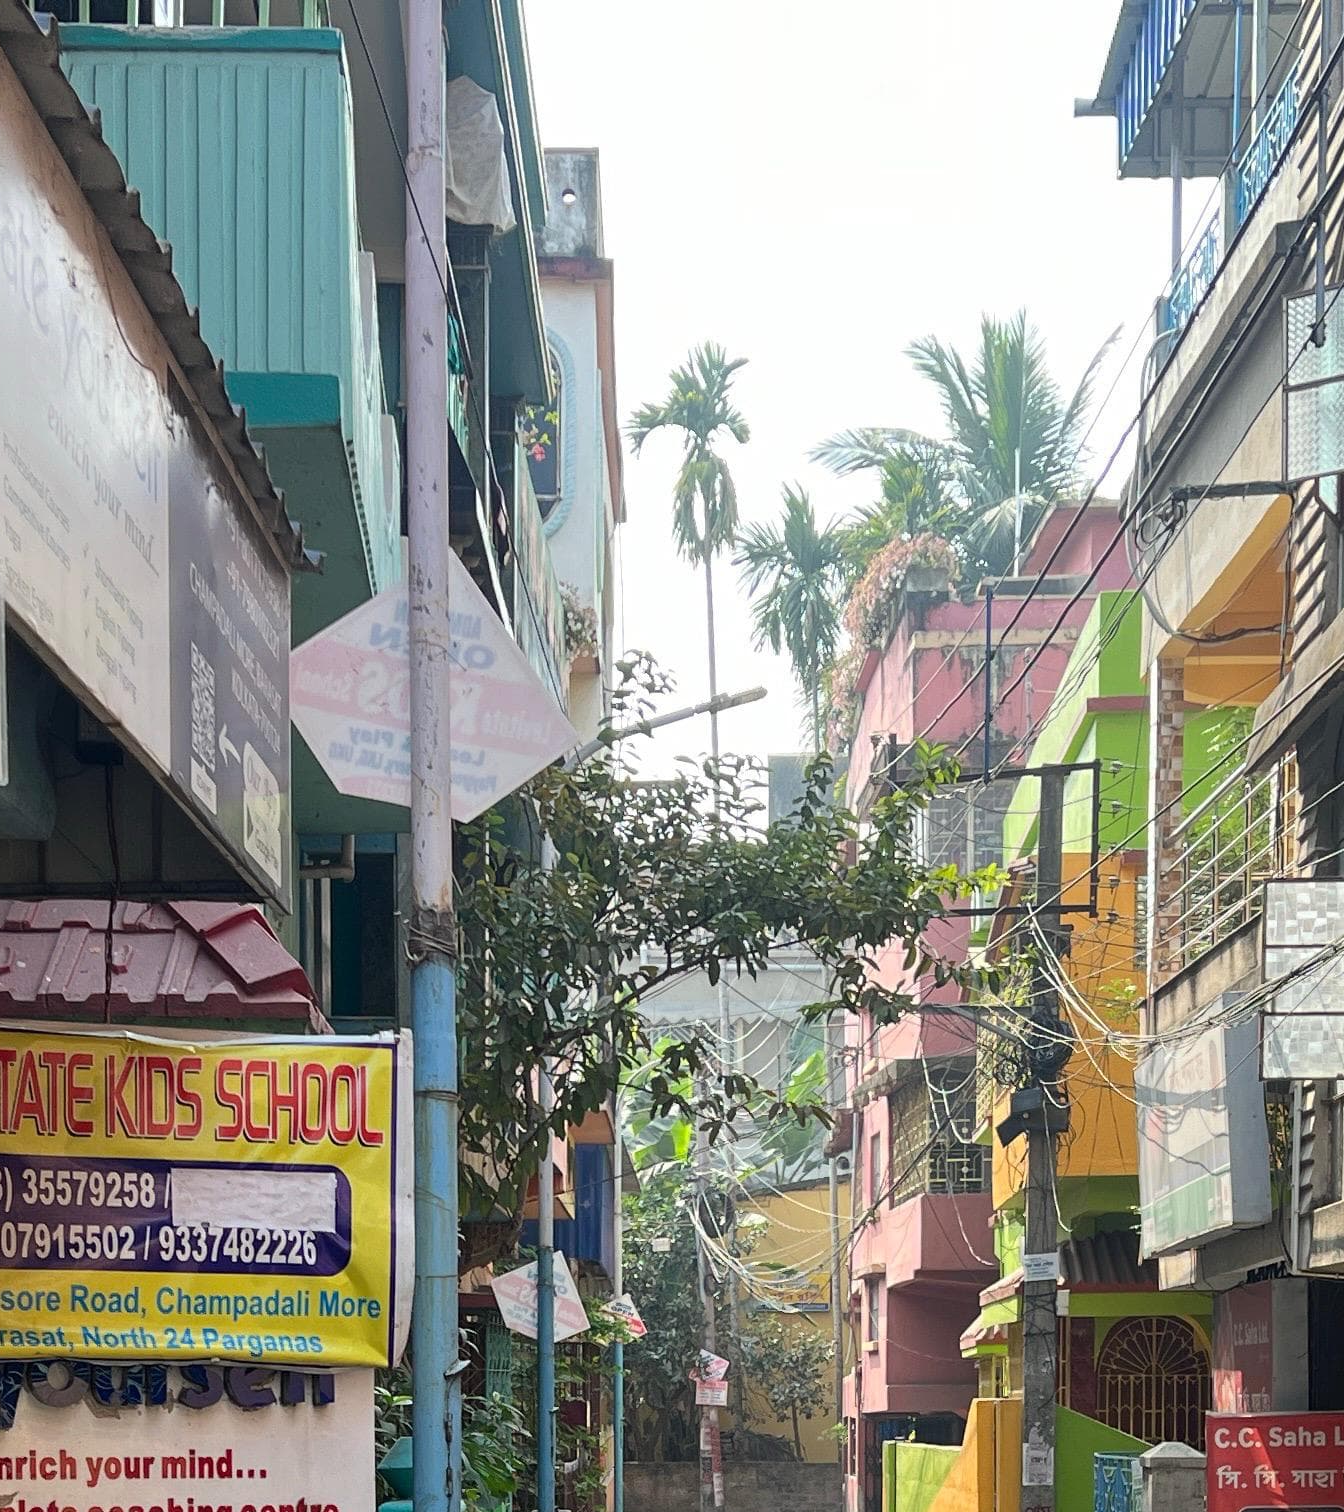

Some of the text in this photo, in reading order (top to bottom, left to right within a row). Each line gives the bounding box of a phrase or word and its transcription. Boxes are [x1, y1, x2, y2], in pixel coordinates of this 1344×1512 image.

[93, 465, 122, 520] your
[107, 1052, 204, 1141] KIDS
[216, 1059, 385, 1147] SCHOOL
[21, 1166, 155, 1210] 35579258
[158, 1226, 318, 1267] 9337482226
[69, 1284, 147, 1318] Road,
[155, 1286, 311, 1326] Champadali
[318, 1289, 382, 1320] More
[81, 1325, 156, 1350] North
[163, 1328, 195, 1352] 24
[201, 1329, 324, 1357] Parganas
[1213, 1426, 1263, 1449] C.C.
[1268, 1426, 1326, 1447] Saha
[86, 1454, 155, 1488] your
[160, 1448, 268, 1480] mind...
[1291, 1468, 1338, 1490] সাহা
